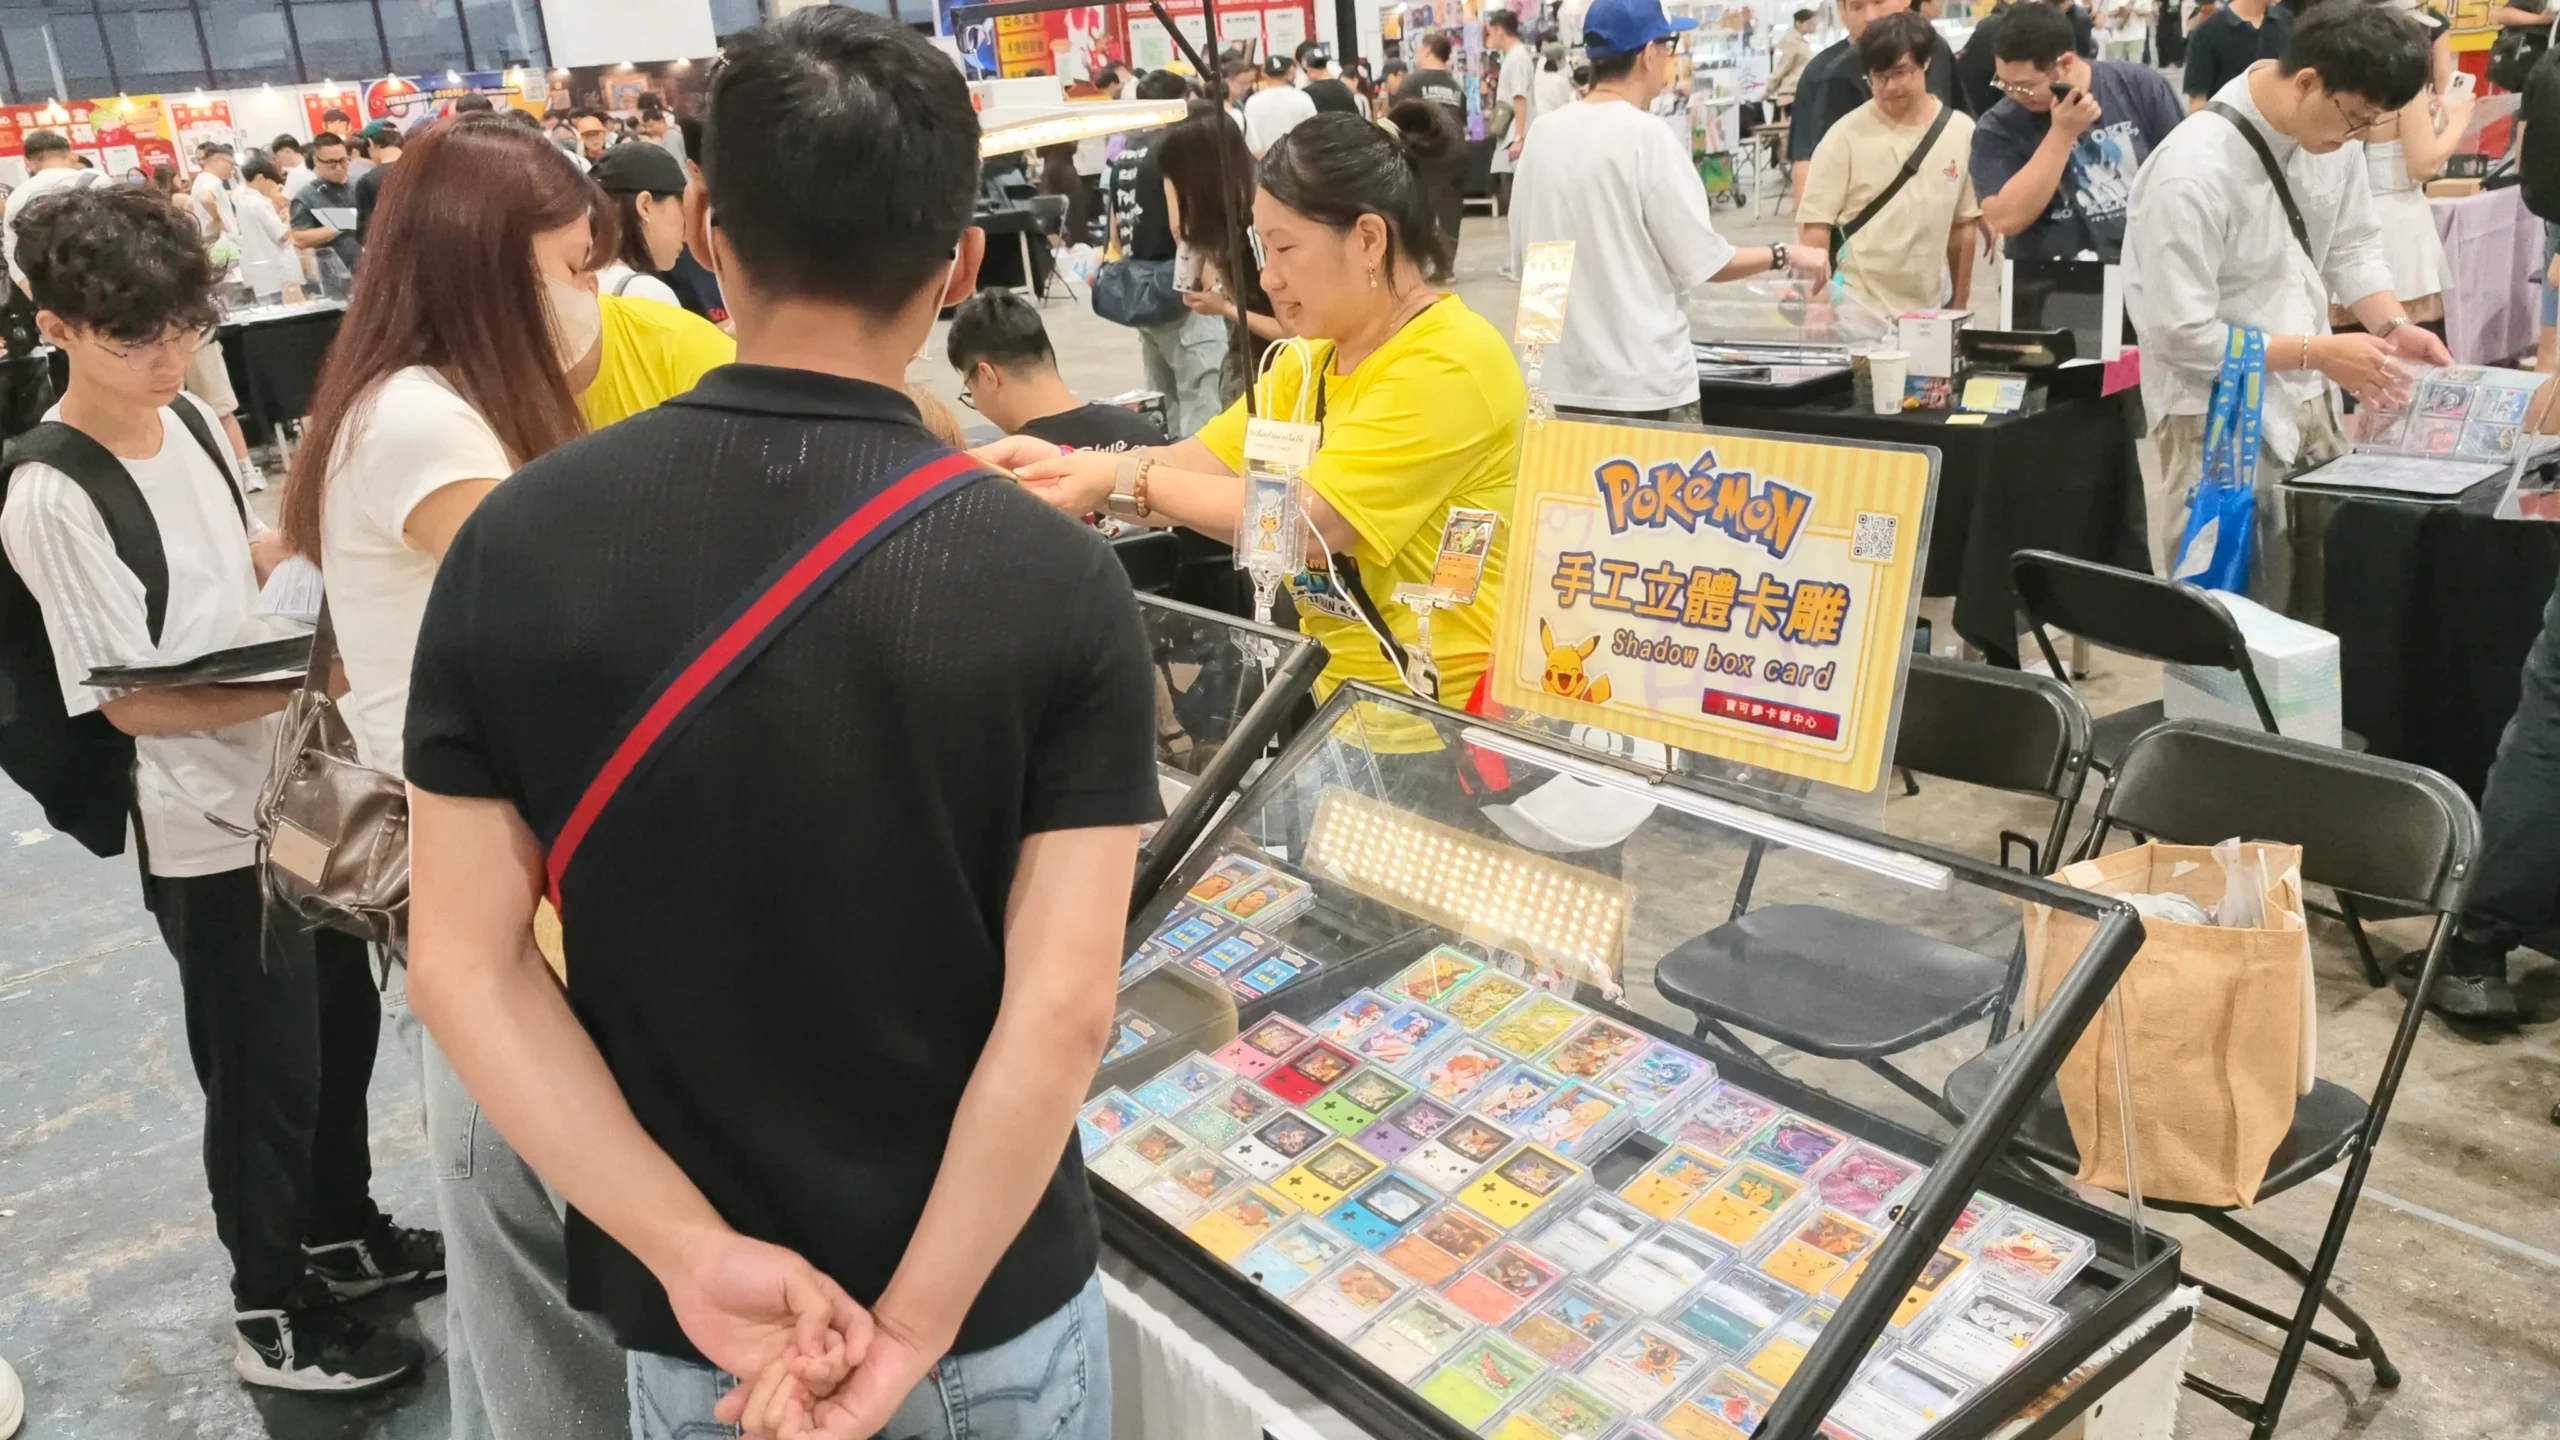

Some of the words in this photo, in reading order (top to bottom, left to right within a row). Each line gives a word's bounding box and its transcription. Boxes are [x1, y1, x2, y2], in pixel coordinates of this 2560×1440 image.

[1552, 551, 1850, 646] 手工立體卡雕
[1612, 629, 1698, 667] Shadow
[1705, 643, 1753, 677] box
[1764, 660, 1836, 691] card
